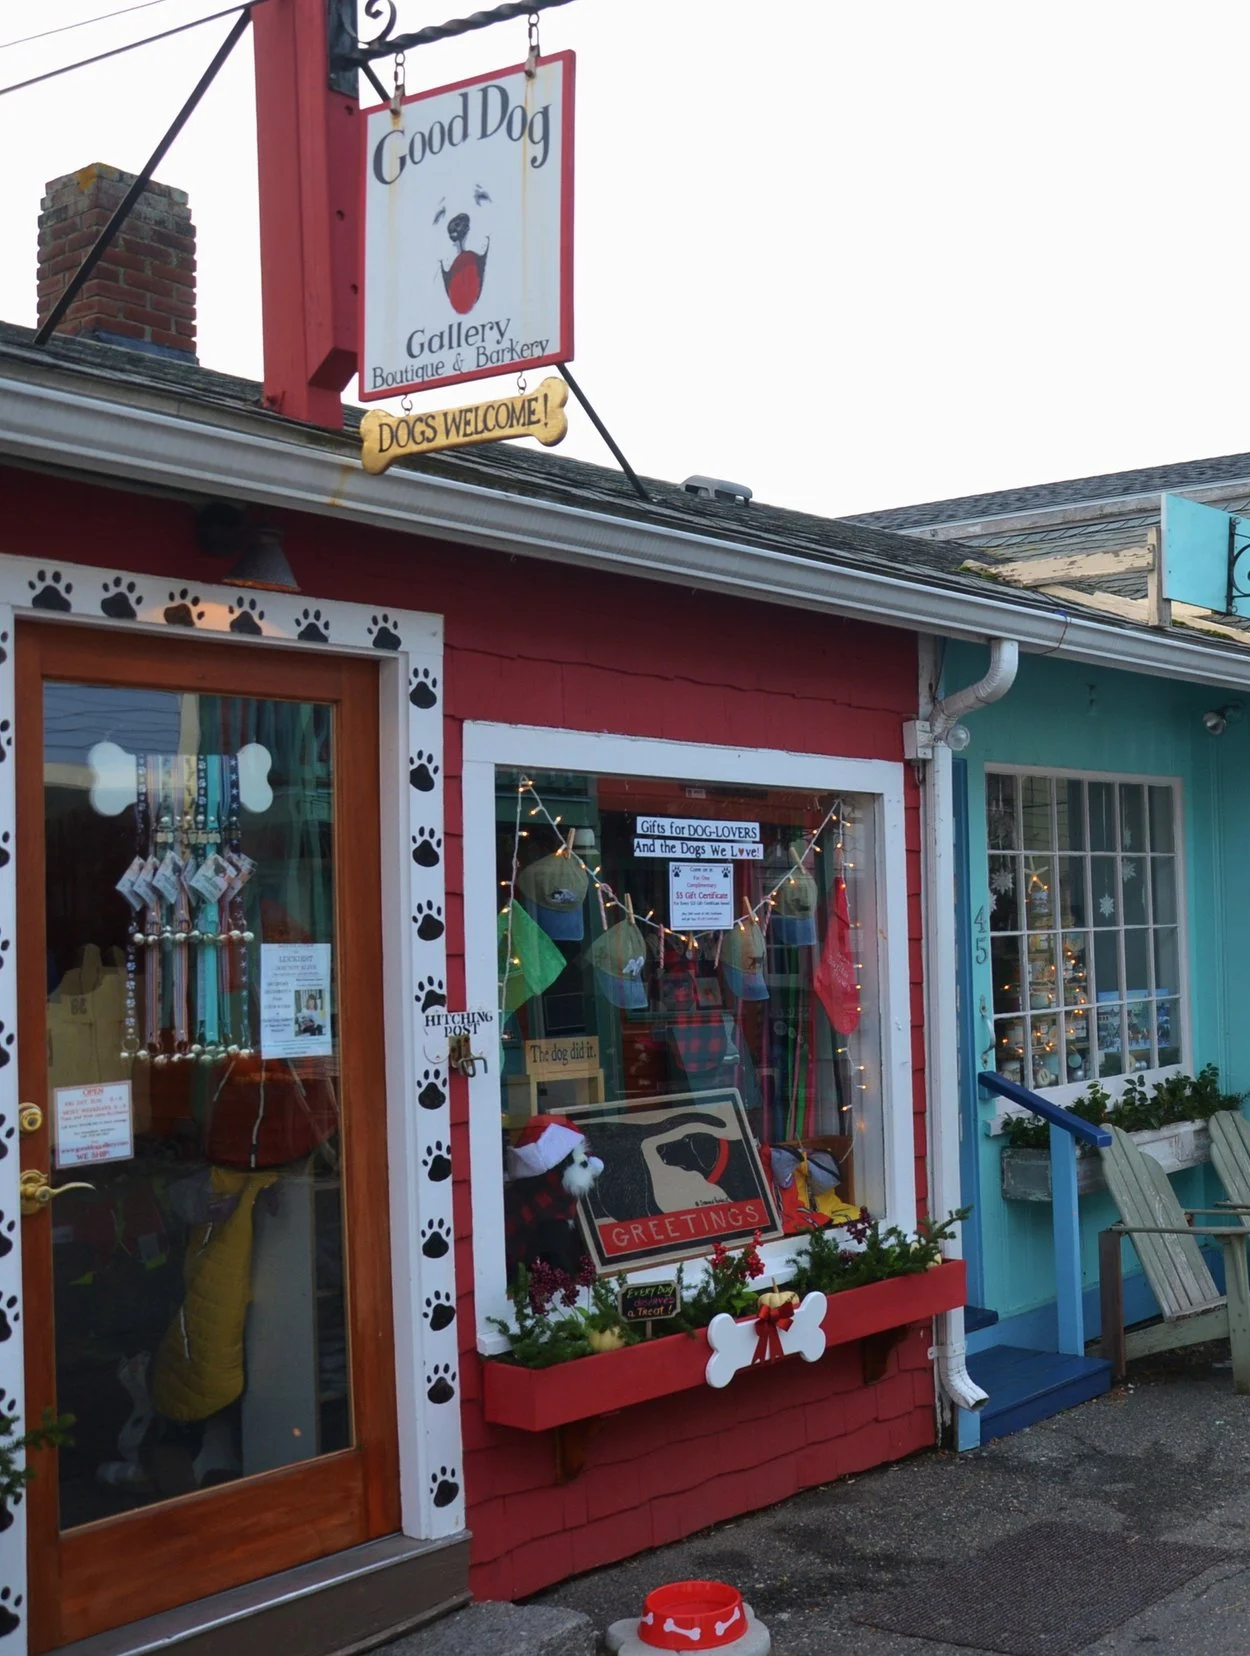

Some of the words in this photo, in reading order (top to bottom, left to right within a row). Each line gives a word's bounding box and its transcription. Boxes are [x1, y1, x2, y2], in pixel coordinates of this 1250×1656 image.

[373, 92, 470, 184] Good
[477, 84, 552, 168] Dog
[406, 318, 511, 359] Gallery
[372, 360, 445, 390] Boutique
[452, 353, 465, 374] &
[475, 338, 549, 368] Barkery
[378, 414, 438, 453] DOGS
[443, 393, 549, 440] WELCOME!
[641, 820, 666, 834] Gifts
[670, 821, 686, 836] for
[688, 824, 758, 839] DOG-LOVERS
[634, 840, 656, 854] And
[660, 840, 677, 854] the
[681, 842, 706, 858] Dogs
[711, 845, 727, 857] We
[685, 891, 697, 899] Gift
[698, 891, 728, 899] Certificate
[425, 1011, 493, 1027] HITCHING
[444, 1022, 481, 1037] POST
[530, 1044, 550, 1063] The
[551, 1044, 569, 1066] dog
[570, 1042, 585, 1060] did
[611, 1205, 760, 1247] GREETINGS
